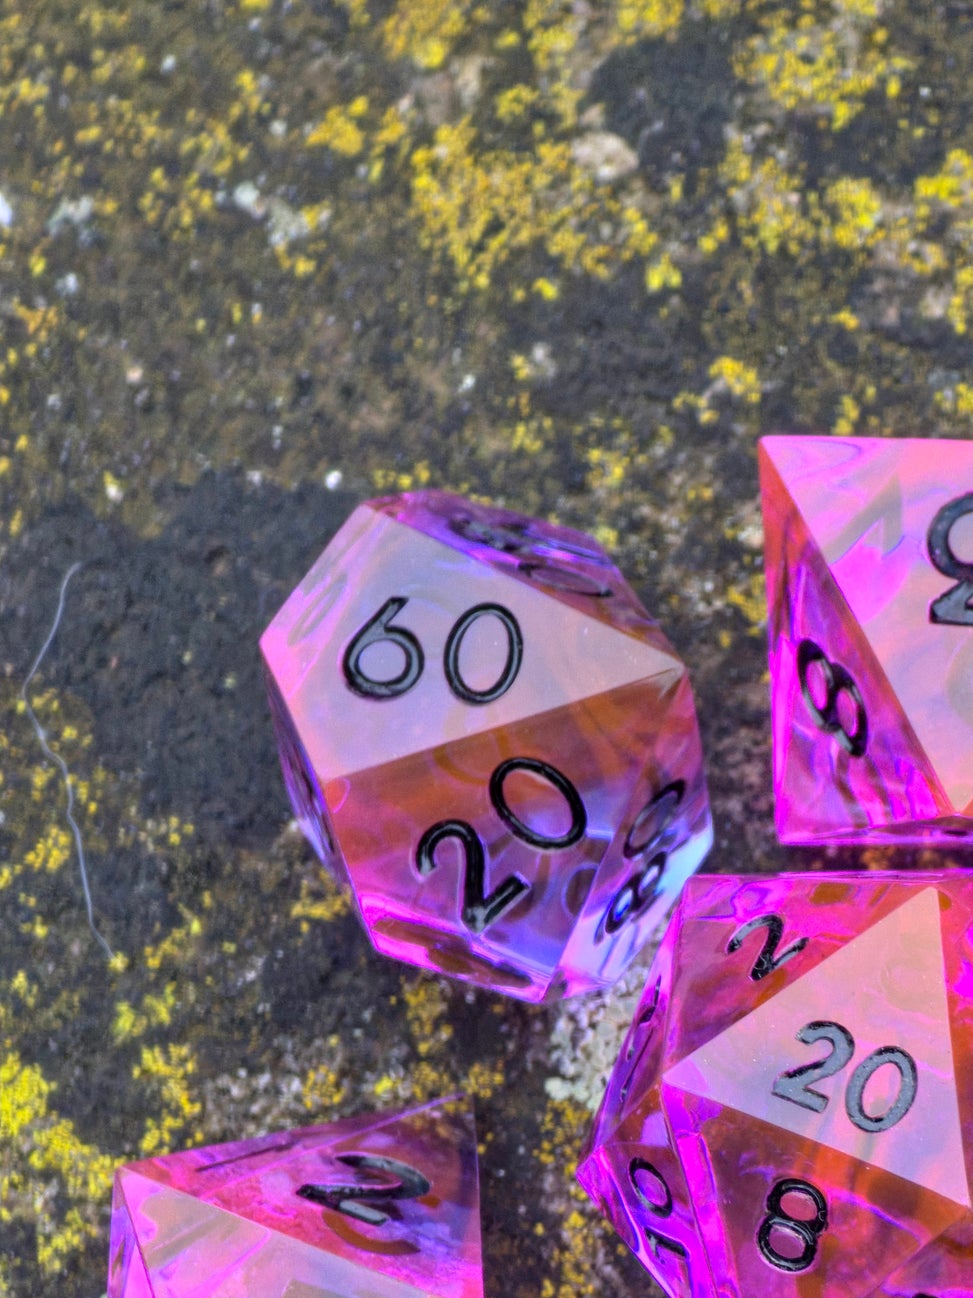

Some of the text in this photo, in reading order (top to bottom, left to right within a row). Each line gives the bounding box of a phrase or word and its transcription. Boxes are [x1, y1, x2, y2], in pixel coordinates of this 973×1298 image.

[341, 596, 524, 705] 60
[416, 757, 588, 932] 20
[725, 913, 811, 982] 2
[771, 1018, 919, 1133] 20
[755, 1176, 829, 1273] 8
